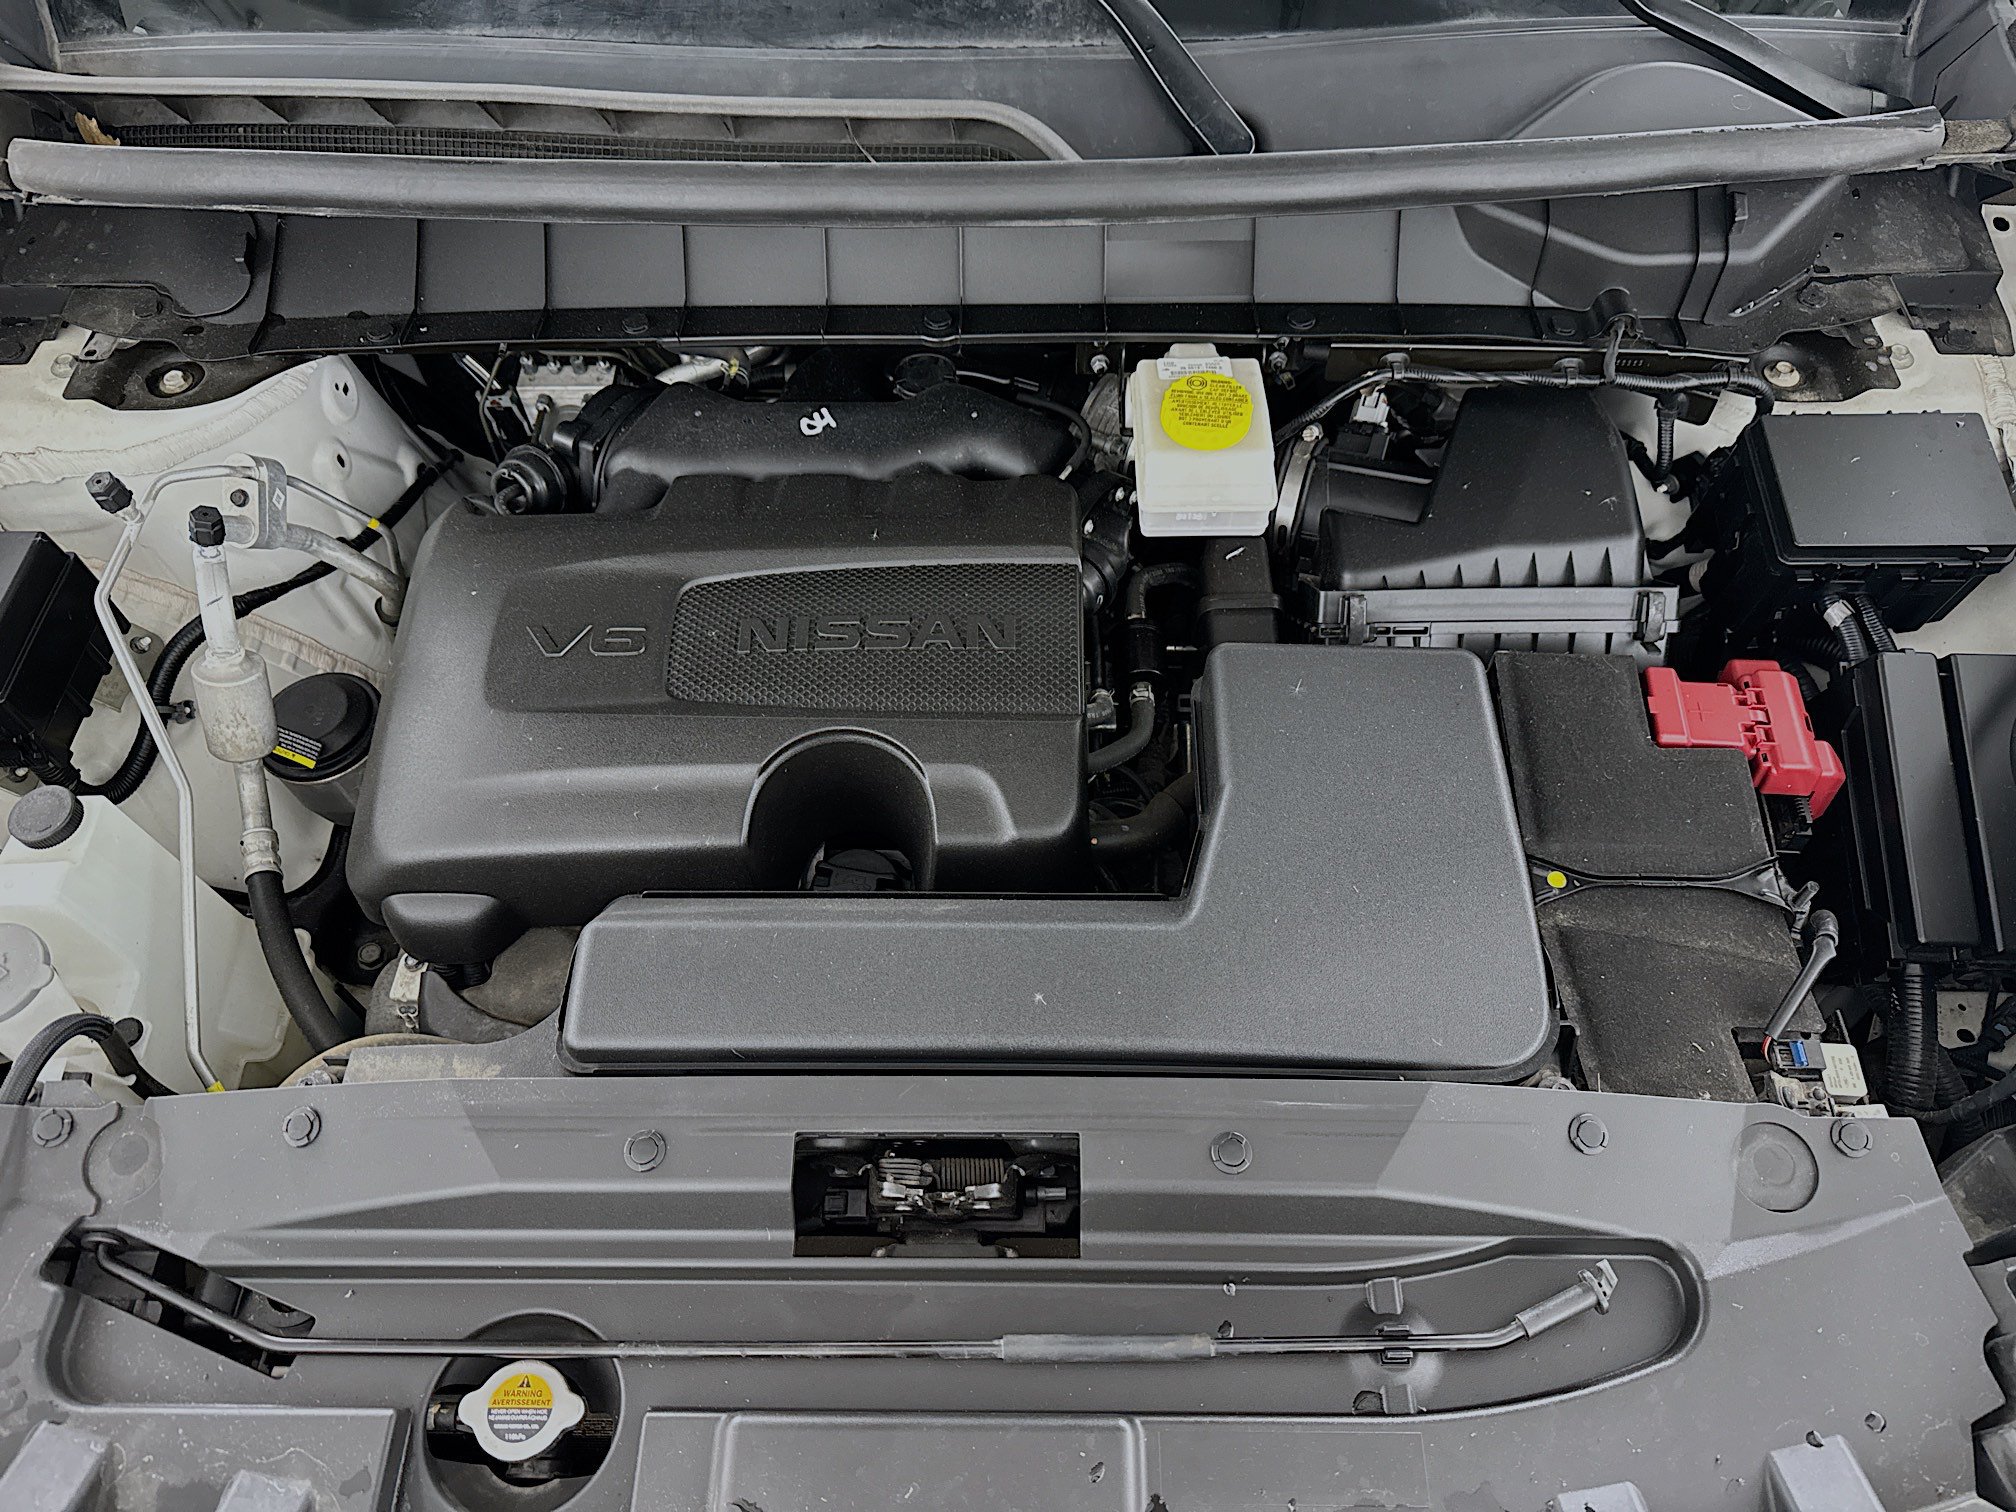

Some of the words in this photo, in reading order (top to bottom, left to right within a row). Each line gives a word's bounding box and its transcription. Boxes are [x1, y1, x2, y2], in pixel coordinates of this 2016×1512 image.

[526, 624, 647, 657] V6
[736, 614, 1017, 652] NISSAN
[503, 1389, 543, 1398] WARNING
